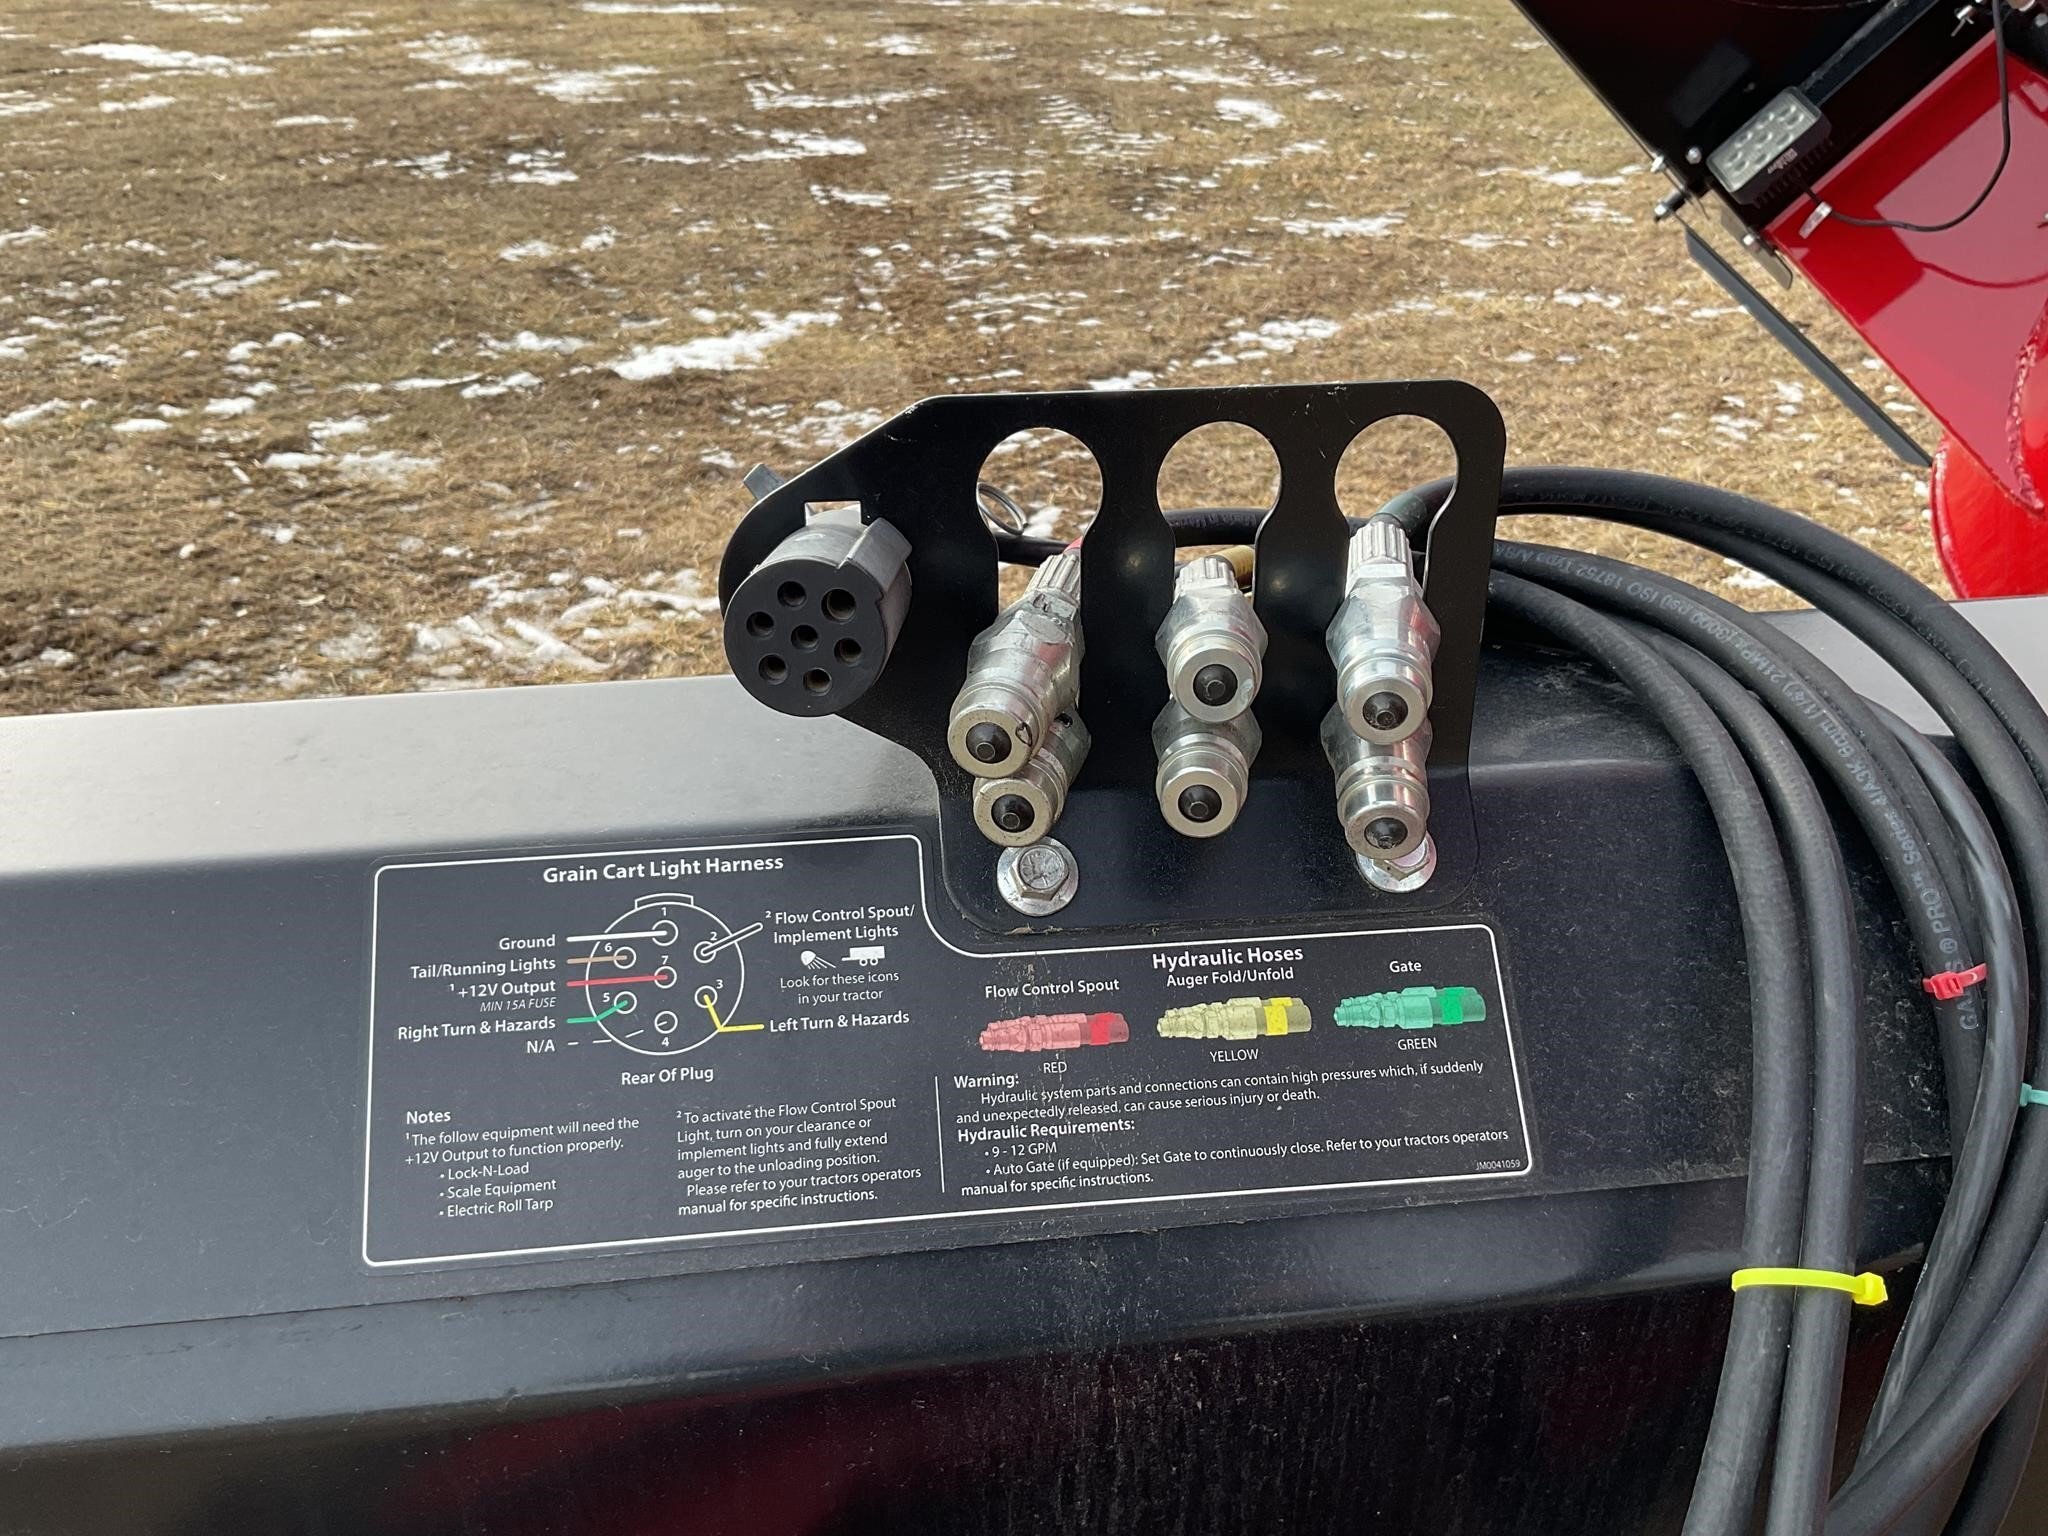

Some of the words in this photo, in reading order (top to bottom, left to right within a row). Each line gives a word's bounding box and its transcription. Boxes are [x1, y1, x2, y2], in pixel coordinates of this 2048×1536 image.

[1626, 582, 1657, 603] ISO
[543, 865, 597, 883] Grain
[602, 863, 645, 879] Cart
[650, 858, 701, 880] Light
[705, 857, 784, 873] Harness
[775, 911, 808, 924] Flow
[812, 906, 864, 922] Control
[868, 904, 915, 921] Spout/
[498, 933, 555, 950] Ground
[774, 928, 852, 946] Implement
[855, 924, 898, 941] Lights
[410, 961, 506, 979] Tail/Running
[510, 957, 556, 974] Lights
[1152, 948, 1243, 973] Hydraulic
[1247, 947, 1303, 963] Hoses
[1389, 960, 1422, 973] Gate
[780, 975, 810, 988] Look
[812, 974, 830, 986] for
[831, 973, 865, 985] these
[868, 971, 899, 982] icons
[1166, 974, 1208, 989] Auger
[1212, 966, 1294, 984] Fold/Unfold
[458, 982, 498, 998] +12V
[501, 980, 556, 998] Output
[798, 993, 809, 1004] in
[812, 993, 840, 1006] your
[842, 989, 883, 1001] tractor
[985, 984, 1018, 1002] Flow
[1022, 980, 1074, 998] Control
[1077, 979, 1120, 997] Spout
[1945, 959, 1979, 1030] GAS
[479, 1000, 503, 1012] MIN
[506, 999, 526, 1010] 15A
[528, 996, 556, 1009] FUSE
[398, 1024, 438, 1042] Right
[440, 1023, 476, 1036] Turn
[479, 1020, 491, 1034] &
[495, 1015, 556, 1032] Hazards
[770, 1017, 798, 1032] Left
[800, 1017, 834, 1030] Turn
[836, 1014, 848, 1027] &
[851, 1010, 910, 1026] Hazards
[526, 1039, 555, 1053] N/A
[1397, 1037, 1437, 1050] GREEN
[1209, 1048, 1258, 1062] YELLOW
[621, 1071, 656, 1085] Rear
[658, 1067, 677, 1082] Of
[680, 1066, 714, 1082] Plug
[1043, 1061, 1067, 1074] RED
[953, 1073, 1019, 1088] Warning:
[980, 1089, 1038, 1107] Hydraulic
[1040, 1085, 1083, 1105] system
[1083, 1082, 1117, 1100] parts
[1118, 1081, 1142, 1095] and
[1144, 1078, 1218, 1093] connections
[1220, 1078, 1242, 1088] can
[1244, 1072, 1288, 1086] contain
[1291, 1070, 1318, 1085] high
[1321, 1069, 1376, 1084] pressures
[1378, 1064, 1418, 1077] which,
[1419, 1062, 1427, 1074] if
[1430, 1060, 1483, 1074] suddenly
[683, 1111, 699, 1124] To
[701, 1105, 752, 1123] activate
[754, 1105, 775, 1119] the
[778, 1103, 808, 1116] Flow
[810, 1098, 856, 1114] Control
[859, 1097, 896, 1112] Spout
[956, 1110, 980, 1124] and
[982, 1103, 1066, 1122] unexpectedly
[1068, 1100, 1121, 1116] released,
[1123, 1102, 1145, 1112] can
[1148, 1099, 1182, 1110] cause
[1184, 1095, 1227, 1108] serious
[1229, 1092, 1264, 1107] injury
[1266, 1092, 1279, 1102] or
[1281, 1087, 1320, 1101] death.
[406, 1110, 451, 1124] Notes
[411, 1133, 436, 1146] The
[438, 1130, 479, 1144] follow
[482, 1124, 554, 1142] equipment
[556, 1120, 579, 1134] will
[582, 1117, 614, 1132] need
[617, 1116, 639, 1129] the
[677, 1129, 714, 1145] Light,
[715, 1128, 742, 1140] turn
[745, 1127, 762, 1137] on
[765, 1124, 794, 1139] your
[796, 1119, 856, 1133] clearance
[858, 1118, 872, 1128] or
[958, 1124, 1027, 1145] Hydraulic
[1030, 1118, 1135, 1138] Requirements:
[404, 1151, 439, 1165] +12V
[442, 1148, 488, 1163] Output
[491, 1147, 506, 1158] to
[508, 1142, 563, 1156] function
[566, 1135, 624, 1154] properly.
[677, 1144, 747, 1162] implement
[750, 1141, 785, 1157] lights
[787, 1137, 812, 1152] and
[814, 1136, 842, 1151] fully
[844, 1131, 887, 1147] extend
[991, 1145, 1000, 1158] 9
[1010, 1143, 1025, 1156] 12
[1028, 1141, 1057, 1155] GPM
[993, 1163, 1023, 1175] Auto
[1025, 1160, 1055, 1173] Gate
[1057, 1157, 1070, 1172] (if
[1072, 1153, 1138, 1172] equipped):
[1140, 1152, 1160, 1165] Set
[1162, 1150, 1192, 1163] Gate
[1194, 1150, 1207, 1161] to
[1210, 1143, 1287, 1160] continuously
[1290, 1141, 1324, 1154] close.
[1326, 1138, 1357, 1151] Refer
[1358, 1138, 1372, 1149] to
[1374, 1137, 1402, 1151] your
[1403, 1134, 1450, 1146] tractors
[1452, 1130, 1509, 1145] operators
[448, 1161, 529, 1180] Lock-N-Load
[677, 1167, 715, 1181] auger
[716, 1165, 731, 1176] to
[733, 1161, 755, 1175] the
[758, 1157, 822, 1173] unloading
[826, 1152, 880, 1169] position.
[1475, 1159, 1520, 1170] JM0041059
[446, 1184, 482, 1199] Scale
[484, 1179, 556, 1197] Equipment
[686, 1183, 728, 1196] Please
[730, 1179, 760, 1193] refer
[762, 1179, 776, 1190] to
[778, 1177, 808, 1192] your
[810, 1173, 858, 1186] tractors
[861, 1168, 921, 1184] operators
[961, 1180, 1008, 1196] manual
[1009, 1179, 1028, 1192] for
[1030, 1175, 1076, 1193] specific
[1078, 1172, 1154, 1187] instructions.
[447, 1202, 494, 1217] Electric
[498, 1198, 522, 1213] Roll
[524, 1198, 553, 1212] Tarp
[678, 1199, 726, 1216] manual
[729, 1198, 748, 1211] for
[750, 1194, 798, 1212] specific
[800, 1189, 878, 1205] instructions.
